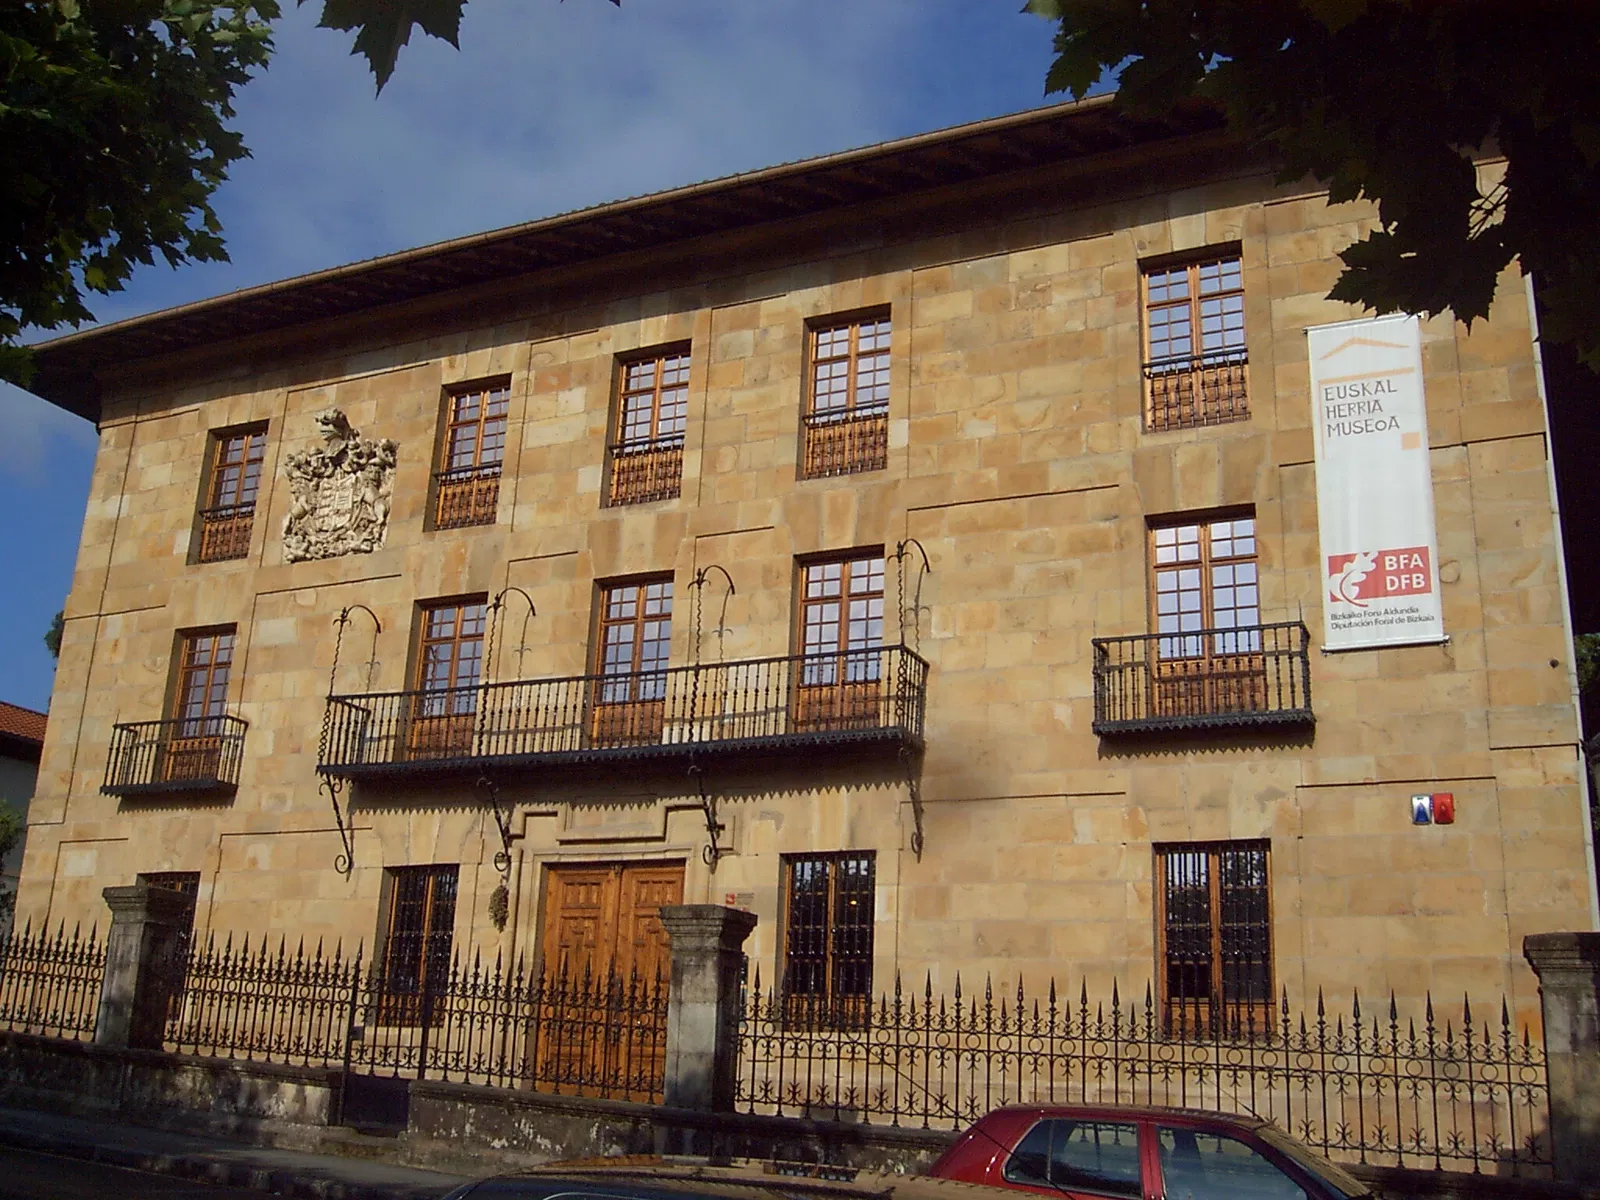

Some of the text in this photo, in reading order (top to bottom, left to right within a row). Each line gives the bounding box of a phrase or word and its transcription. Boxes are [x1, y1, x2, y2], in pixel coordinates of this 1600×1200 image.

[1324, 379, 1398, 401] EUSKAL
[1326, 400, 1384, 419] HERRIA
[1327, 416, 1400, 438] MUSEOA
[1384, 553, 1425, 571] BFA
[1385, 573, 1425, 591] DFB
[1395, 616, 1406, 624] de
